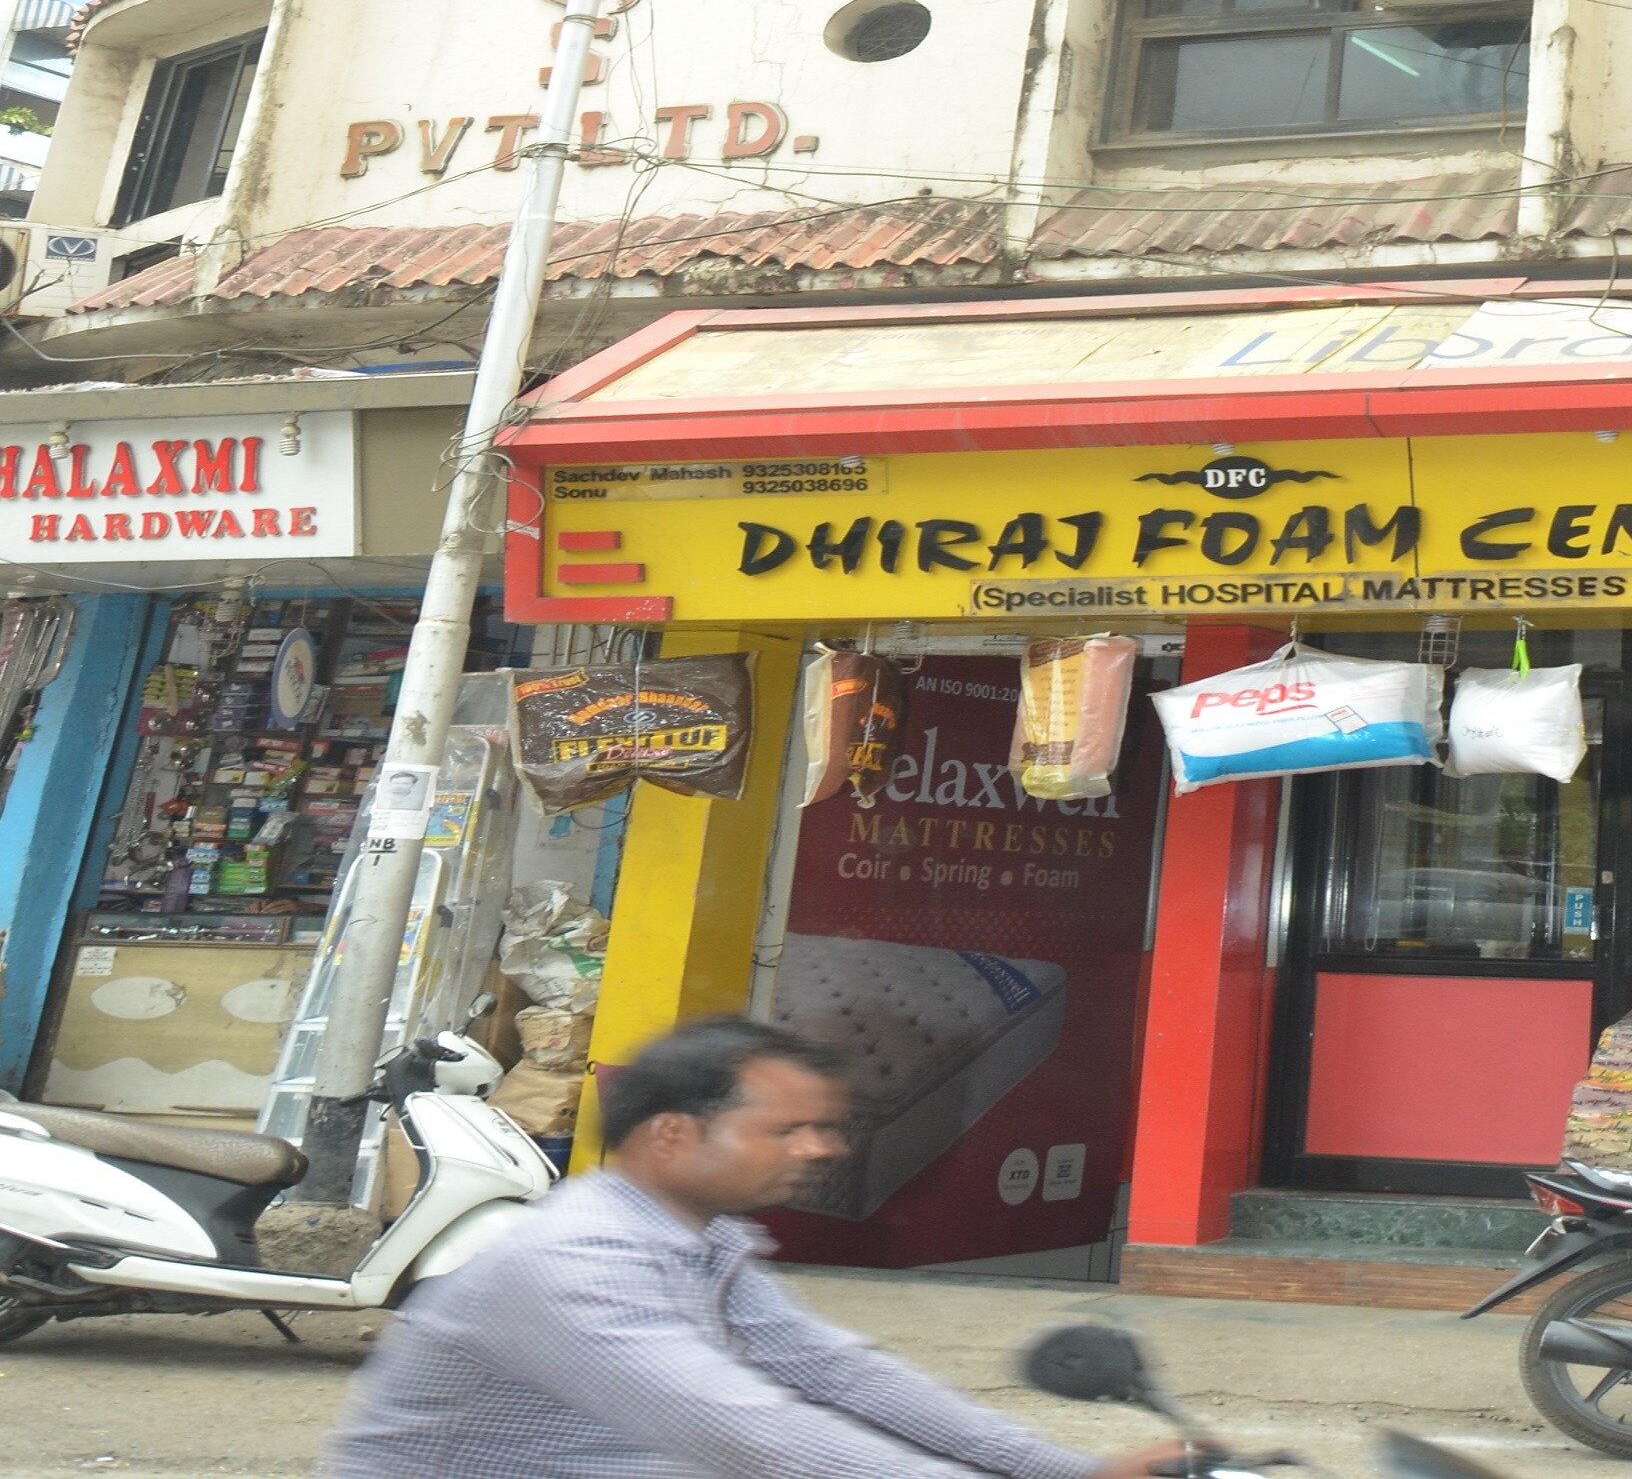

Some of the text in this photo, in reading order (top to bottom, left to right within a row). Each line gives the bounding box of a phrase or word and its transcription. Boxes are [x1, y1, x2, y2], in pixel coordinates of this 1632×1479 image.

[554, 470, 640, 483] Sachdev
[554, 479, 868, 499] Sonu 9325038696
[1204, 466, 1267, 488] DFC
[29, 507, 318, 542] HARDWARE
[737, 512, 1104, 577] DHIRAJ
[1132, 503, 1421, 569] FOAM
[971, 576, 1627, 611] (Specialist HOSPITAL MATTRESSES
[916, 677, 936, 691] AN
[940, 680, 962, 694] ISO
[1190, 681, 1316, 719] peps
[848, 814, 1115, 858] MATTRESSES
[837, 853, 1080, 890] Coir Spring Foam
[1573, 894, 1585, 926] PUSH
